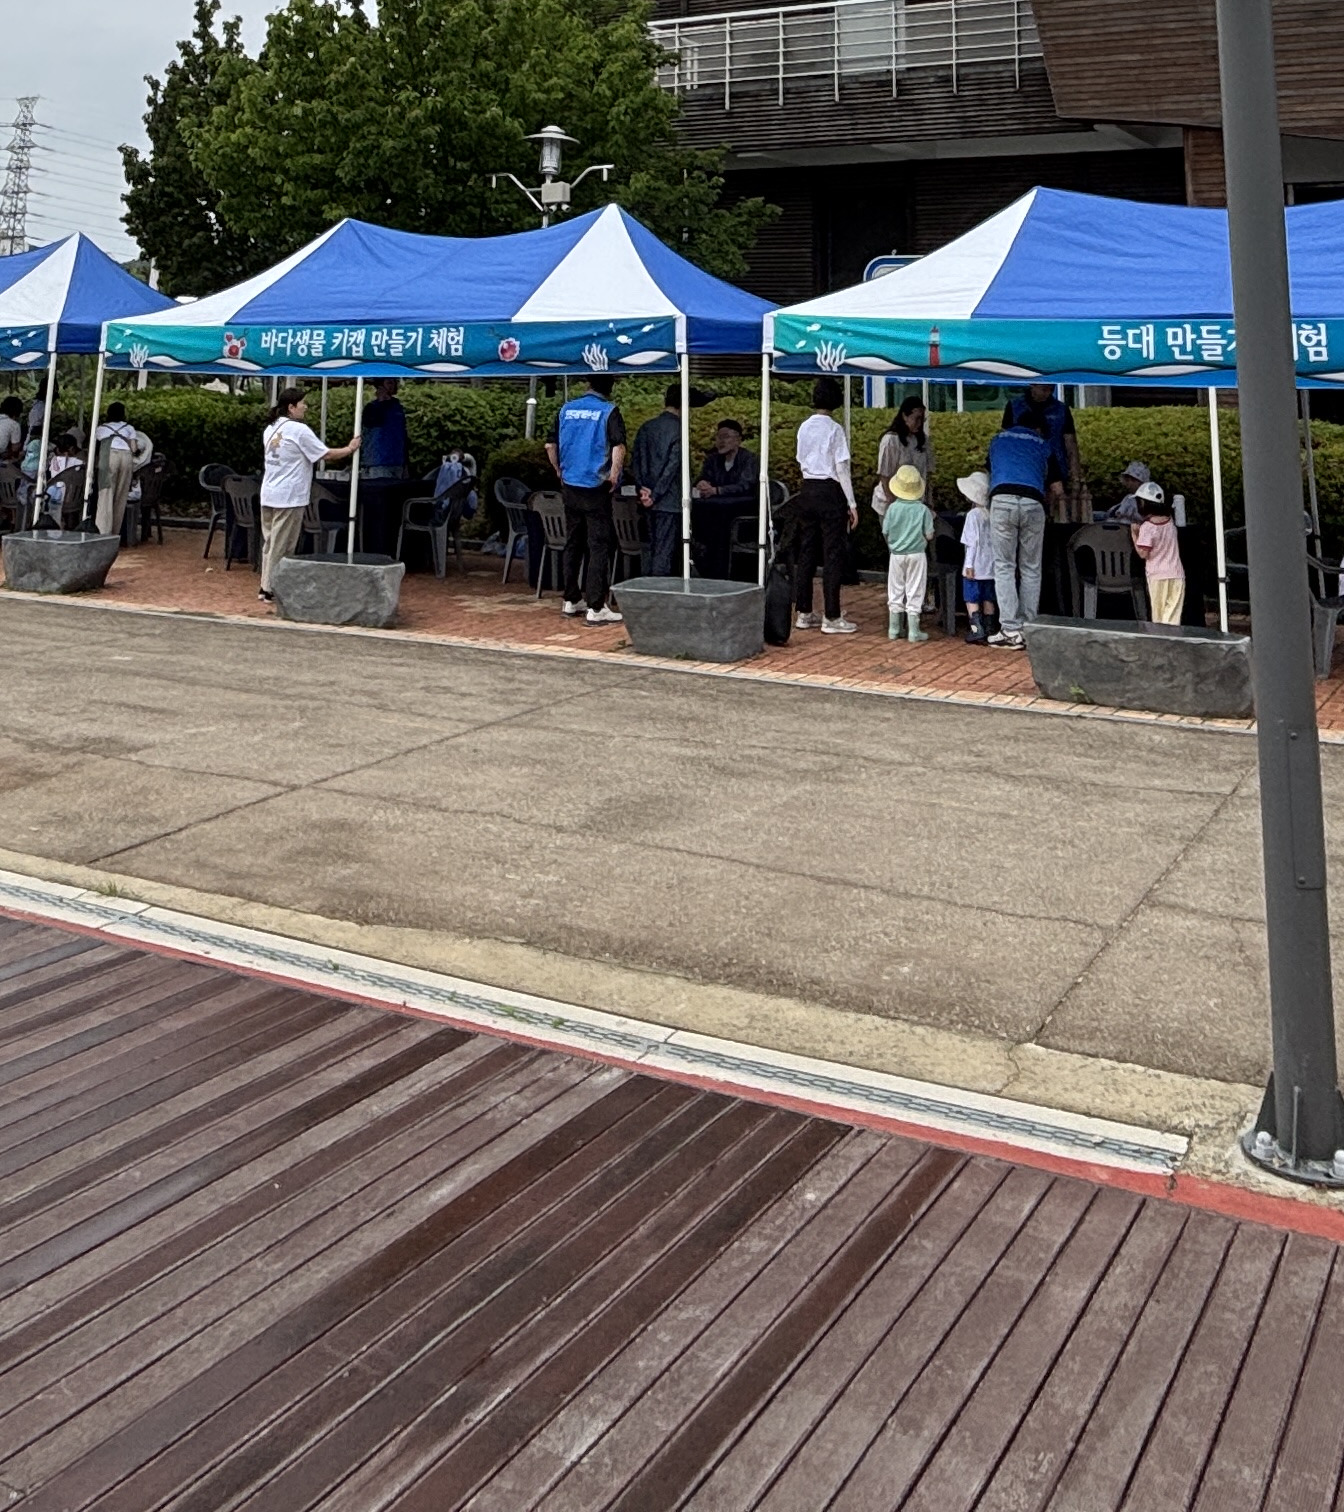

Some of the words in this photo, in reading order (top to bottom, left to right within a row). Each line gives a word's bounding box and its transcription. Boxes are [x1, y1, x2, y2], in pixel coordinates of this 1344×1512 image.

[260, 328, 326, 357] 바다생물
[330, 328, 366, 357] 키캡
[370, 328, 423, 357] 만들기
[428, 326, 465, 357] 체험
[1097, 324, 1155, 361] 등대
[1165, 323, 1237, 361] 만들
[1291, 323, 1329, 363] 험
